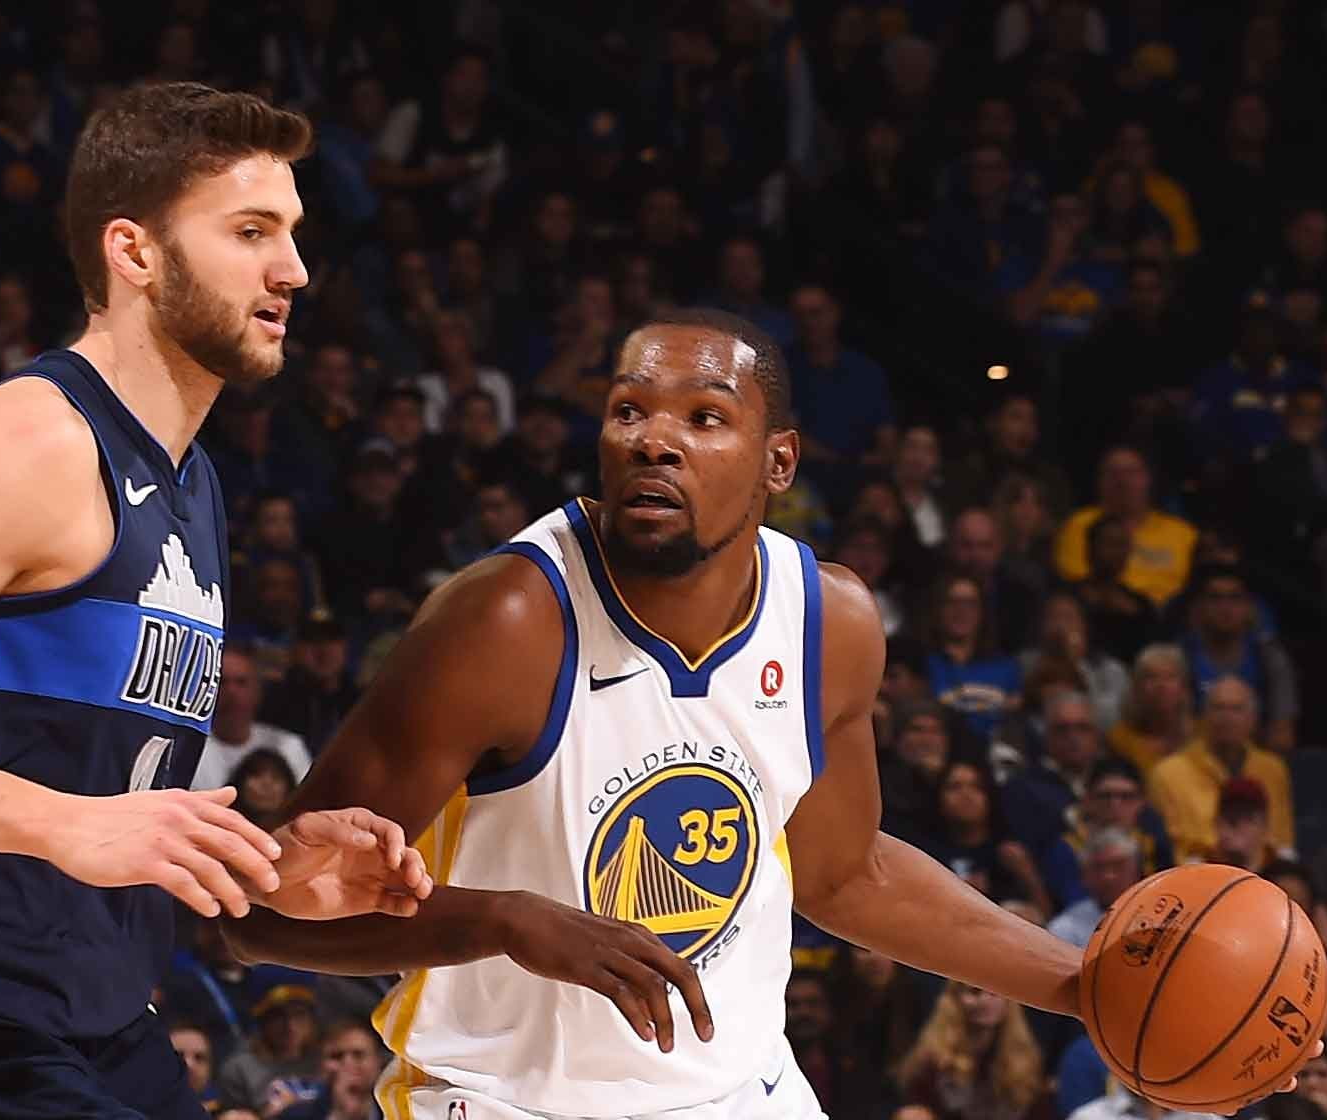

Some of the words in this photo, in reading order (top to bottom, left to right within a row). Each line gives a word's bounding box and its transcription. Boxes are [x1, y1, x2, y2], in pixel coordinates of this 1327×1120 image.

[587, 741, 699, 816] GOLDEN
[707, 744, 765, 802] STATE
[672, 805, 742, 866] 35
